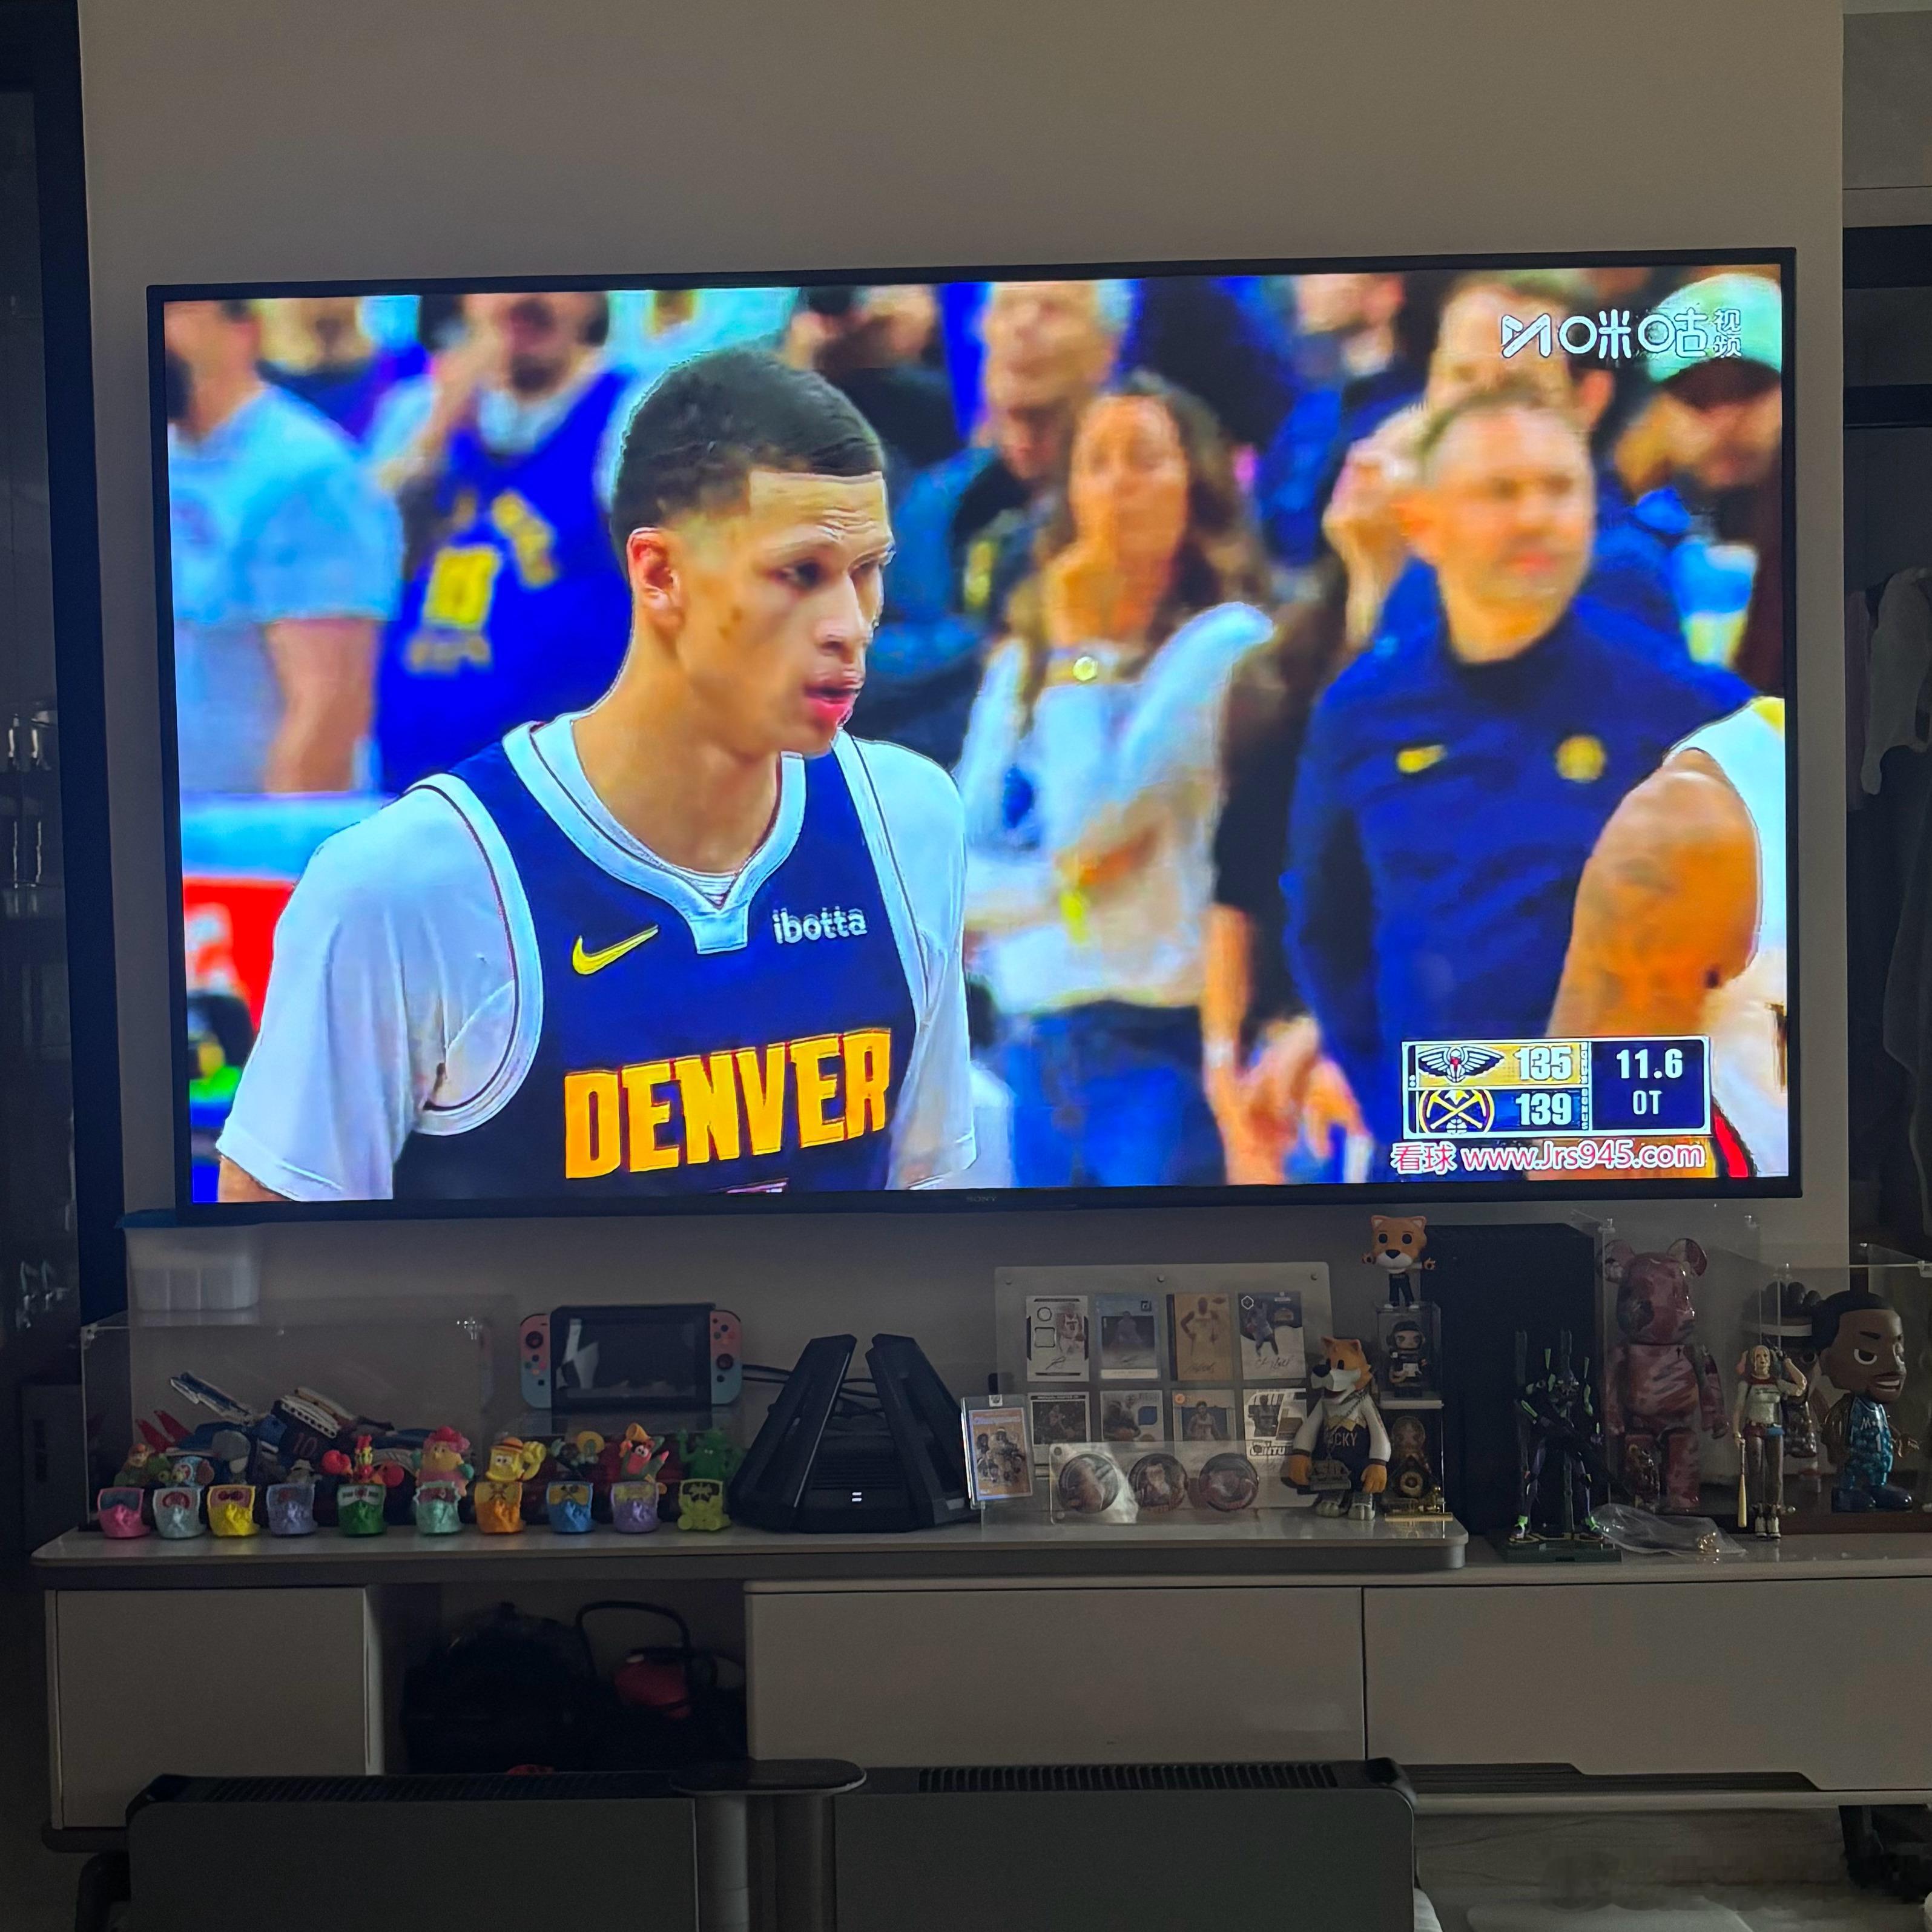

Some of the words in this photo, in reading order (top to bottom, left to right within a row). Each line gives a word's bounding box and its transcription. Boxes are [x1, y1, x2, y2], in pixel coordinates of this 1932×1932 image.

[773, 907, 868, 944] ibotta
[1515, 1046, 1572, 1081] 135
[1617, 1049, 1683, 1079] 11.6
[564, 1027, 891, 1179] DENVER
[1515, 1093, 1572, 1126] 139
[1633, 1090, 1662, 1115] OT
[1391, 1142, 1456, 1174] 看球
